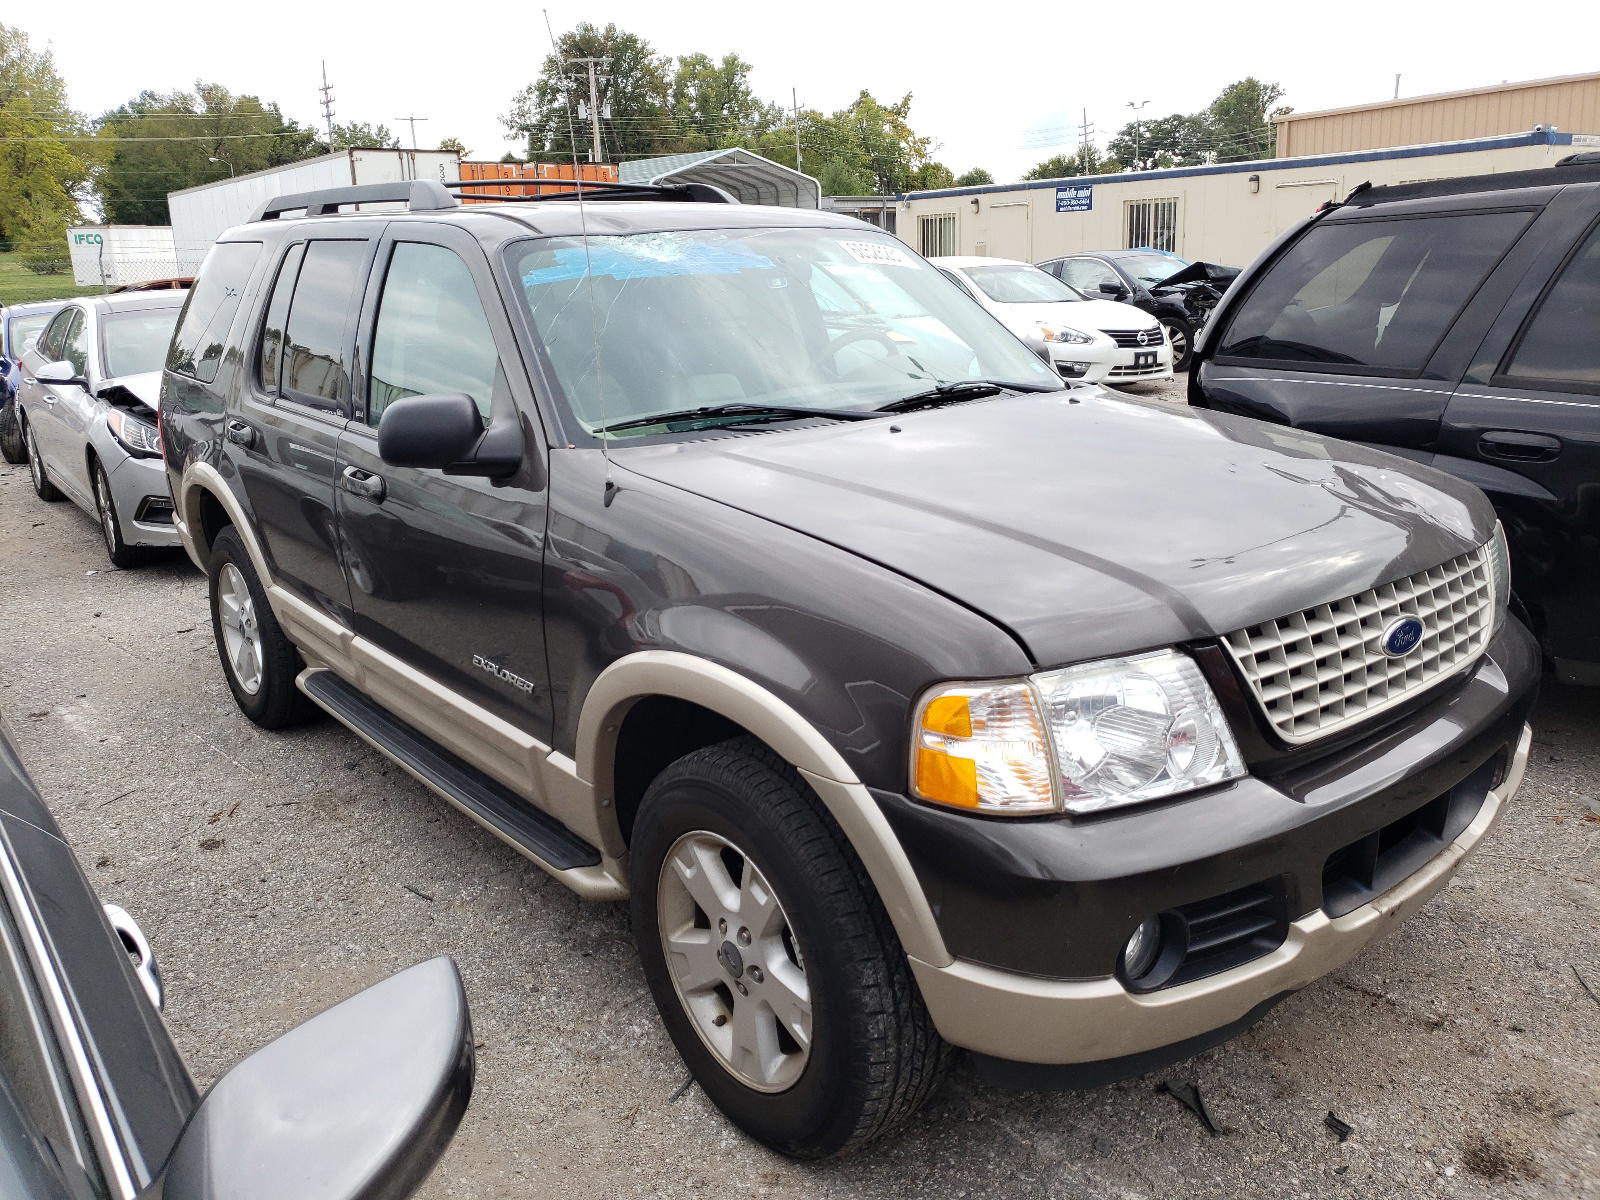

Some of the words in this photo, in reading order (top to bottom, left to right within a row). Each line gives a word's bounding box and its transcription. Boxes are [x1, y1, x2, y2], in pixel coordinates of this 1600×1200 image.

[74, 233, 103, 245] IFCO
[1394, 625, 1416, 647] Ford
[472, 654, 535, 694] EXPLORER
